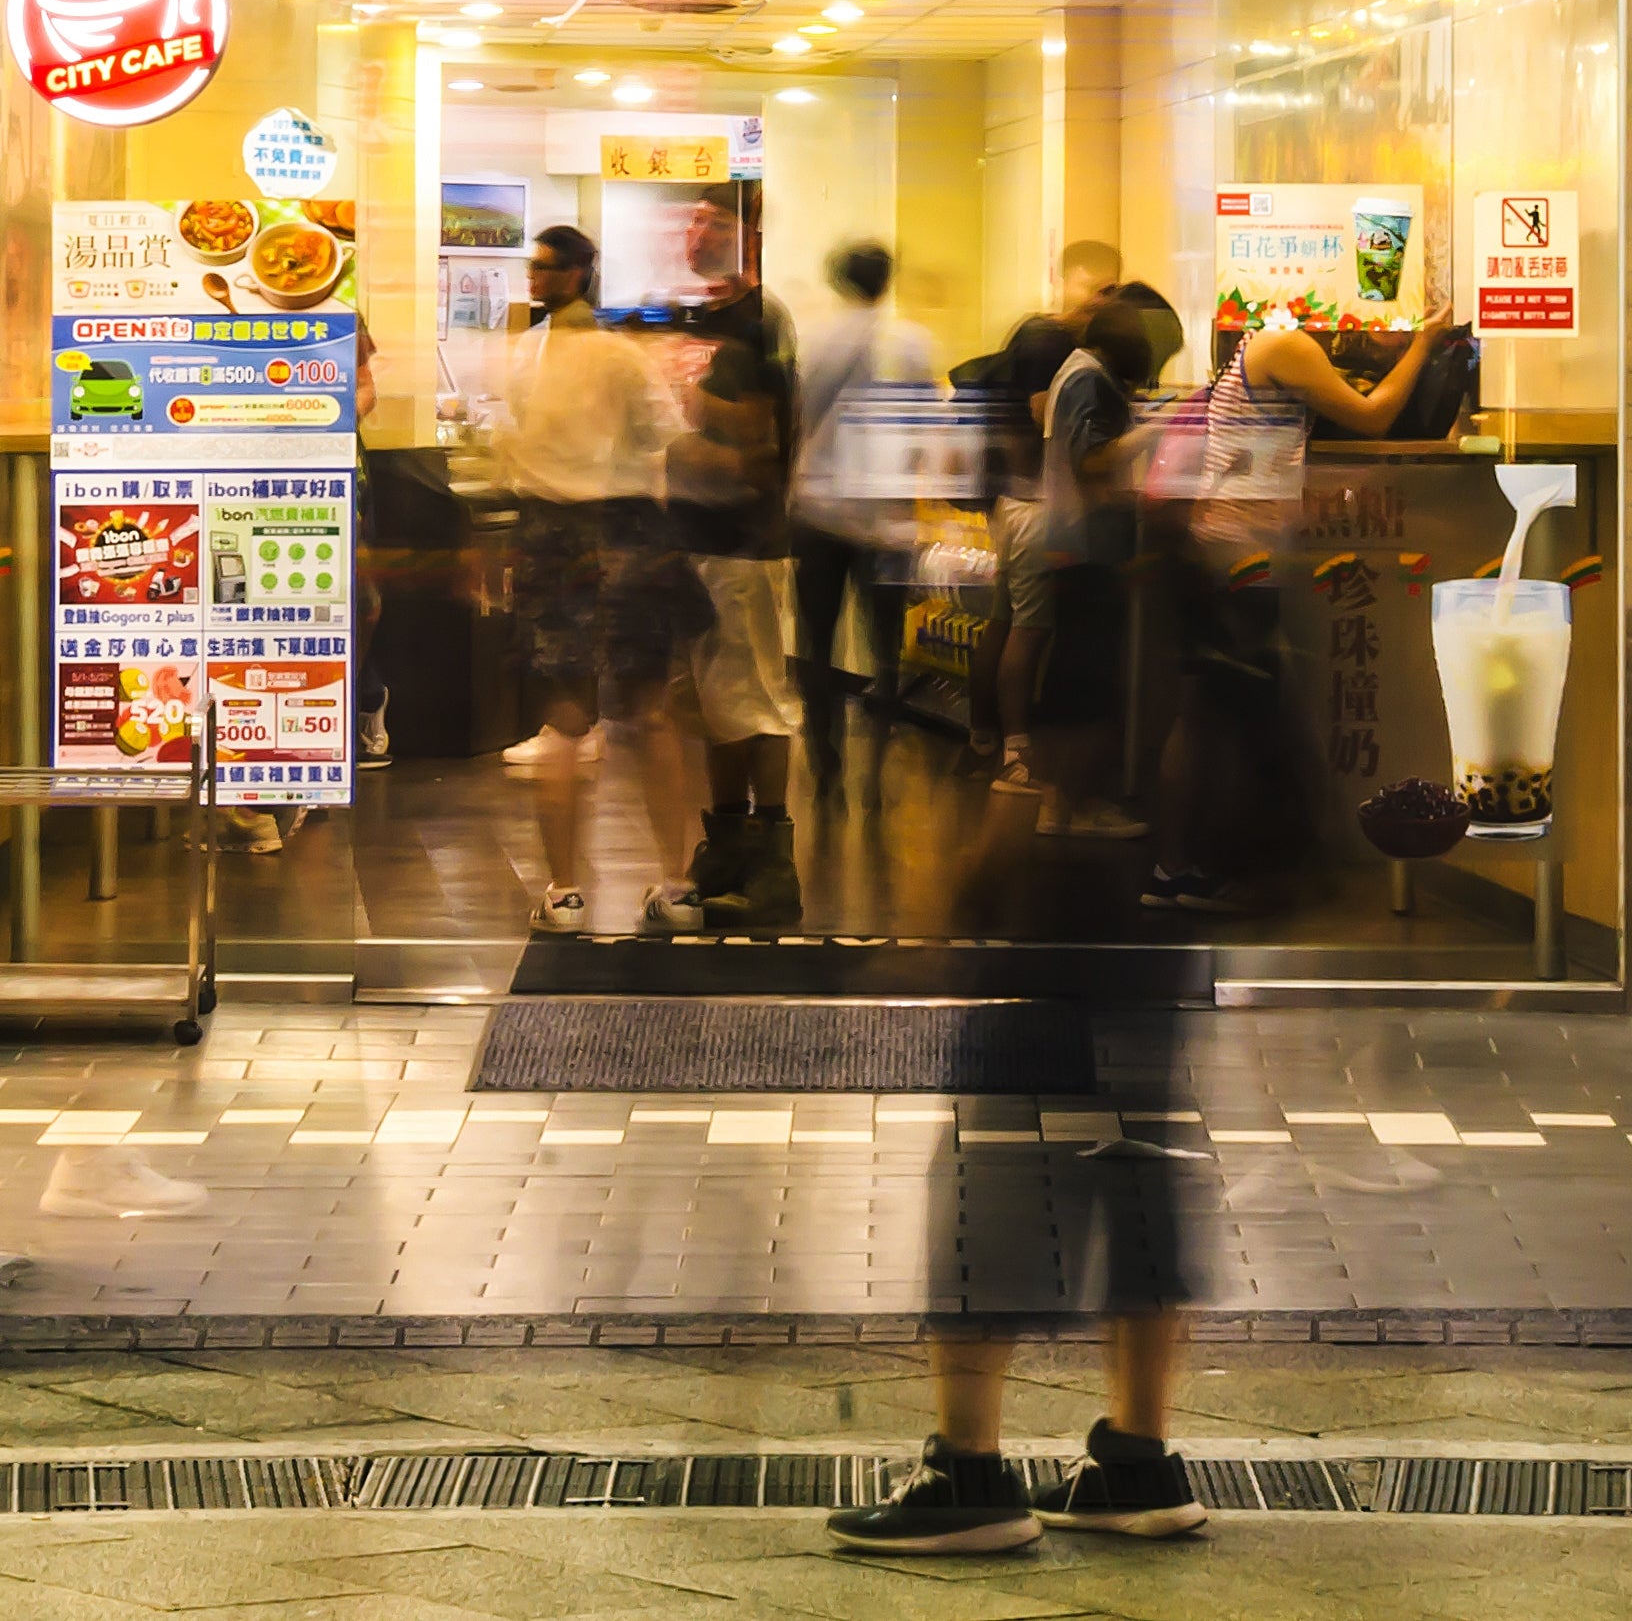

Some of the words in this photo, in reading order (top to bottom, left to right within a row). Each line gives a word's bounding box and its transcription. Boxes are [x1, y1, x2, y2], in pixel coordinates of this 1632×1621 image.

[46, 54, 117, 93] CITY
[121, 34, 204, 77] CAFE
[610, 146, 714, 177] 收銀台
[64, 233, 172, 270] 湯品賞
[1229, 232, 1345, 259] 百花爭妍杯
[167, 609, 196, 626] plus
[1328, 560, 1380, 778] 珍珠撞奶
